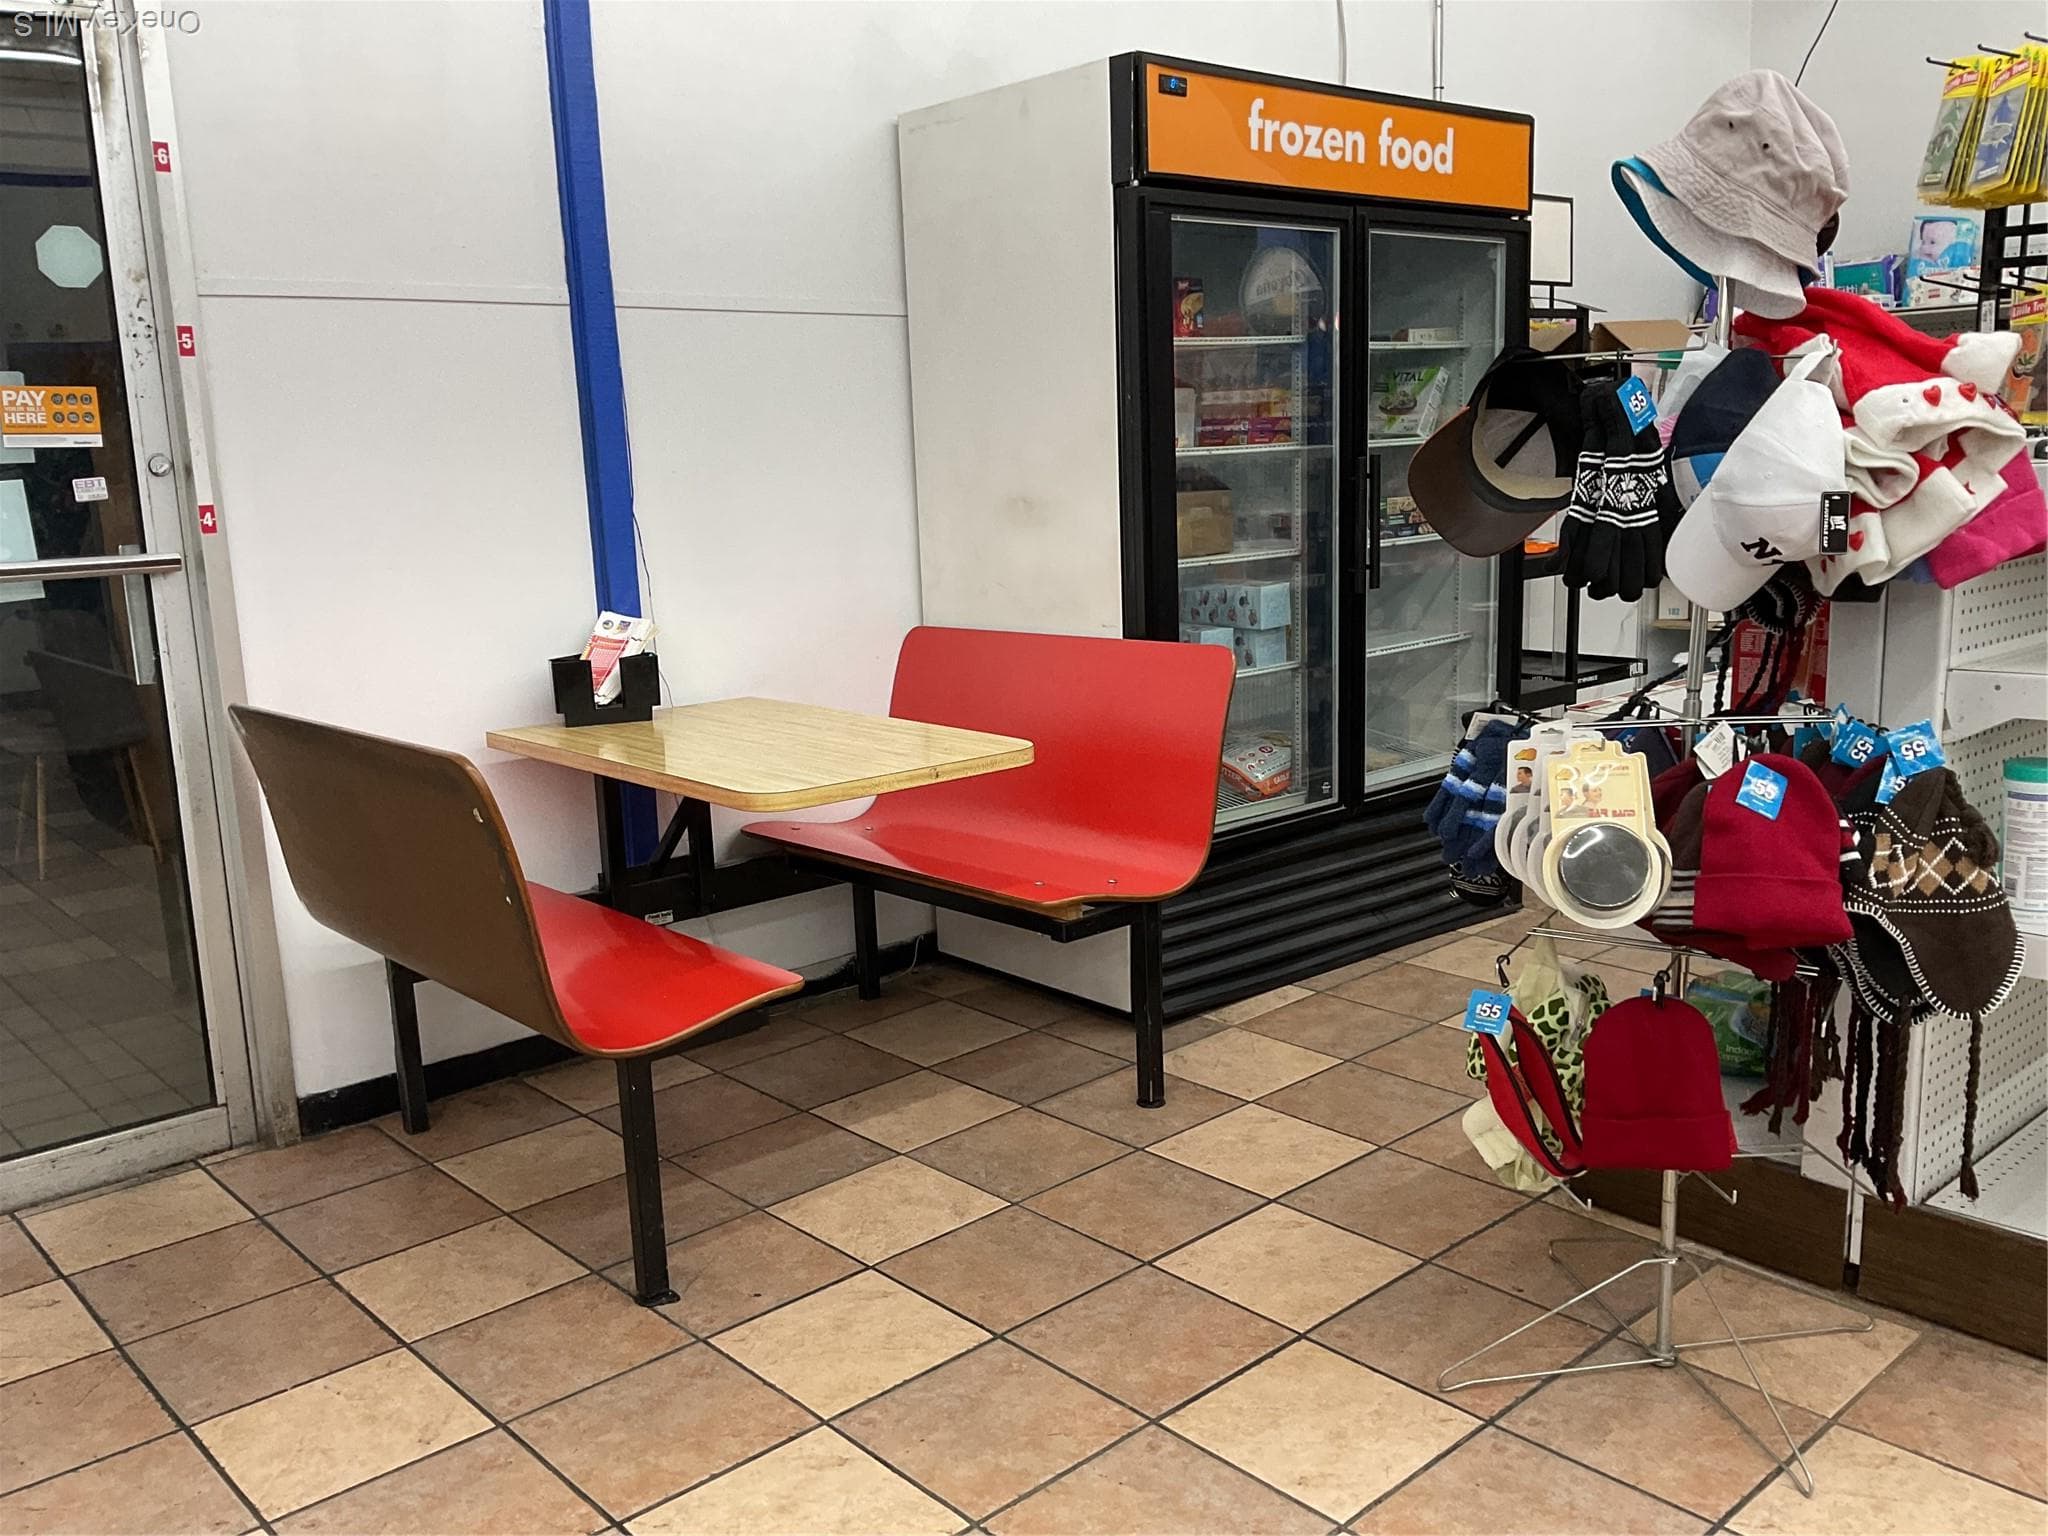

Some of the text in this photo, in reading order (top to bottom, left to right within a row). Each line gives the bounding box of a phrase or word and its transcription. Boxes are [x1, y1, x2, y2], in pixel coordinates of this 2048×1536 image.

[1249, 98, 1454, 175] frozen food
[157, 148, 168, 165] 6
[182, 332, 192, 349] 5
[1393, 371, 1424, 382] VITAL
[2, 390, 47, 406] PAY
[4, 412, 48, 424] HERE
[75, 480, 103, 489] EBT
[202, 511, 213, 527] 4
